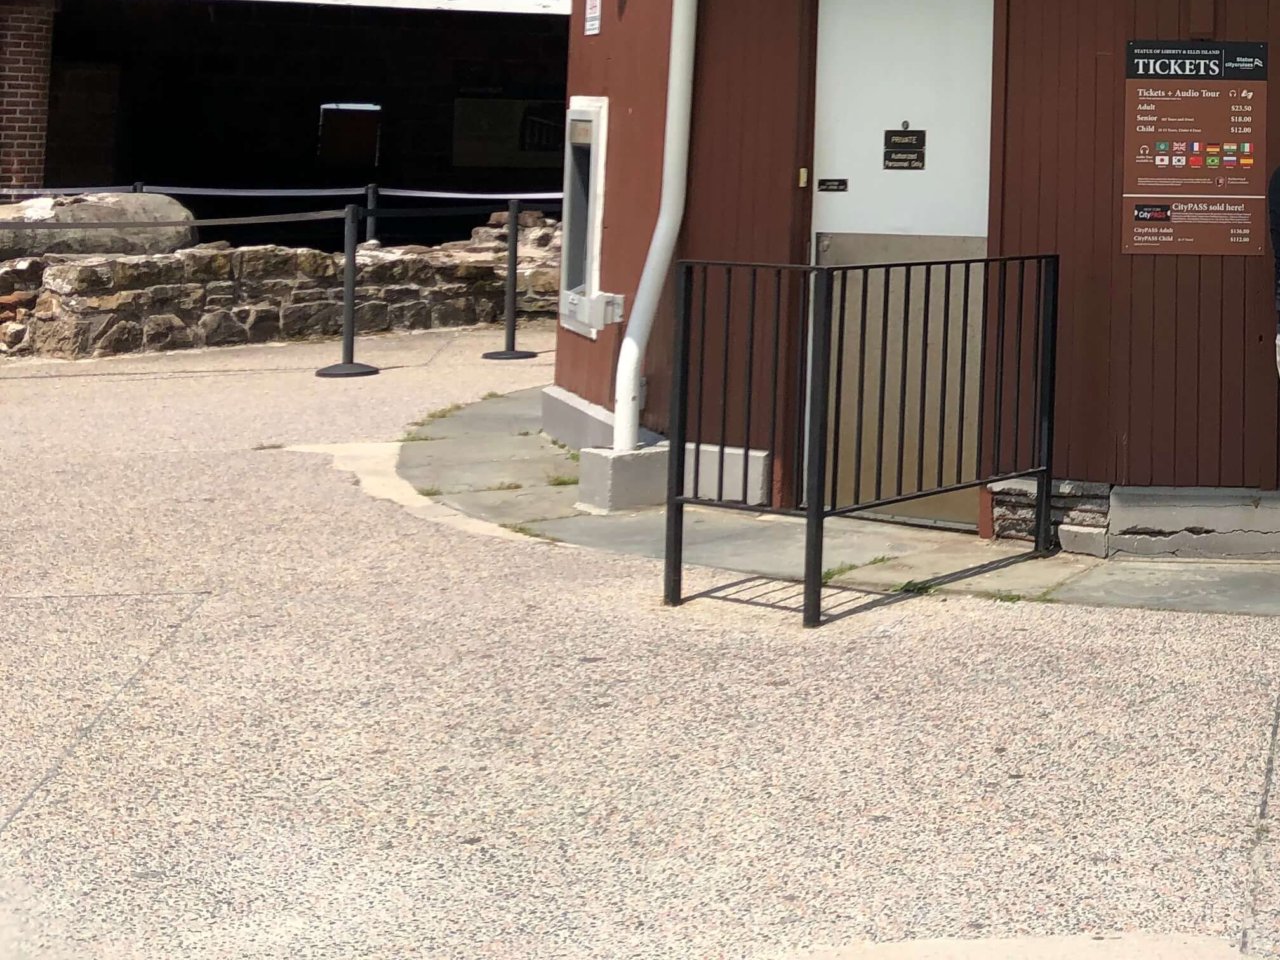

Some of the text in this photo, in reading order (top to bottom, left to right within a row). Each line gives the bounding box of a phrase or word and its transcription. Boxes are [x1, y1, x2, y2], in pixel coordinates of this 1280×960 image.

[1134, 59, 1220, 76] TICKETS
[1137, 88, 1165, 97] Tickets
[1175, 89, 1199, 98] Audio
[1137, 103, 1155, 111] Adult
[1136, 114, 1158, 122] Senior
[1136, 125, 1155, 133] Child
[891, 136, 918, 144] PRIVATE
[1172, 202, 1245, 212] CityPASS sold here!
[1138, 211, 1167, 220] CityPASS
[1134, 235, 1158, 243] CityPASS
